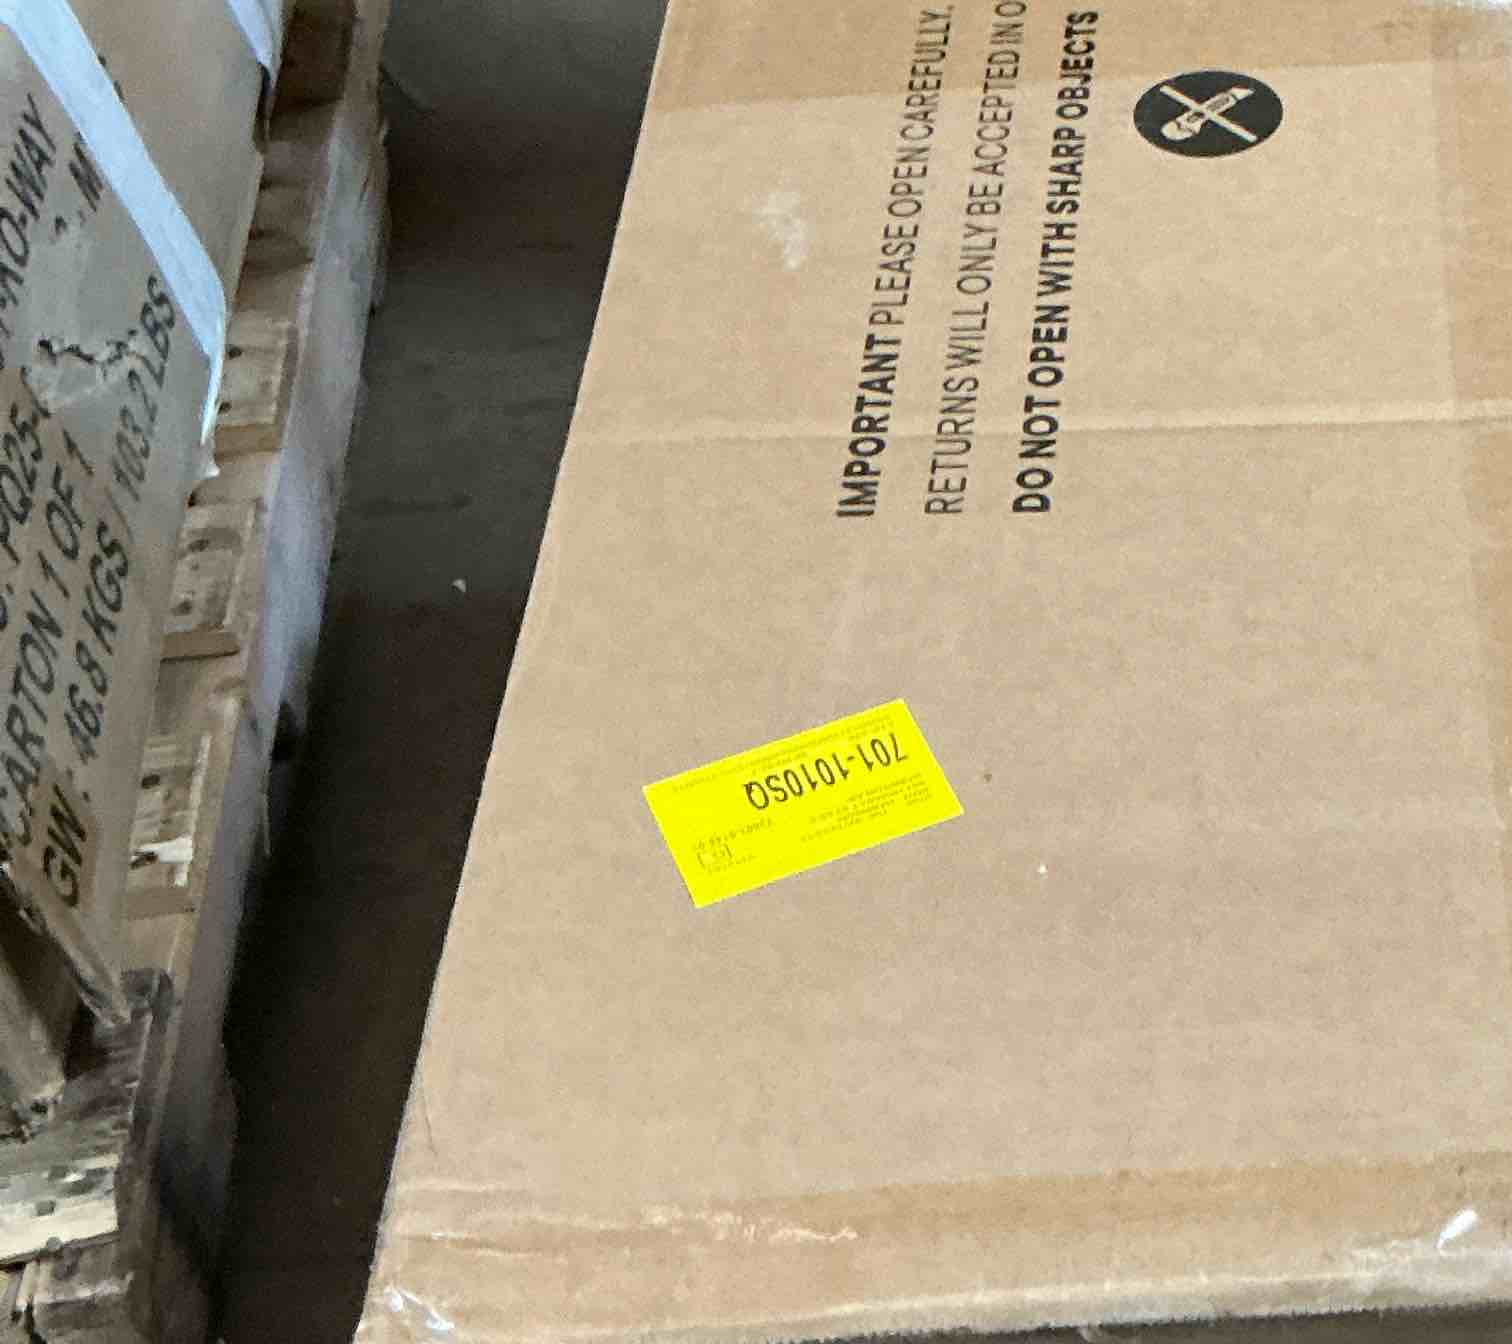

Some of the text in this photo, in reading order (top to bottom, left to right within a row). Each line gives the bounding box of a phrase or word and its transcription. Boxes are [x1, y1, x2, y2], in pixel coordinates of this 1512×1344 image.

[989, 21, 1025, 45] IN
[972, 49, 1021, 177] ACCEPTED
[965, 181, 1004, 216] BE
[835, 5, 955, 518] IMPORTANT PLEASE OPEN CAREFULLY.
[956, 222, 1000, 296] ONLY
[1011, 9, 1100, 513] DO NOT OPEN WITH SHARP OBJECTS
[944, 301, 991, 371] WILL
[62, 428, 95, 477] 1
[81, 519, 131, 656] KGS
[131, 274, 176, 390] LBS
[924, 375, 980, 515] RETURNS
[45, 461, 84, 557] OF
[37, 550, 71, 599] 1
[743, 732, 910, 812] 701-1010SQ
